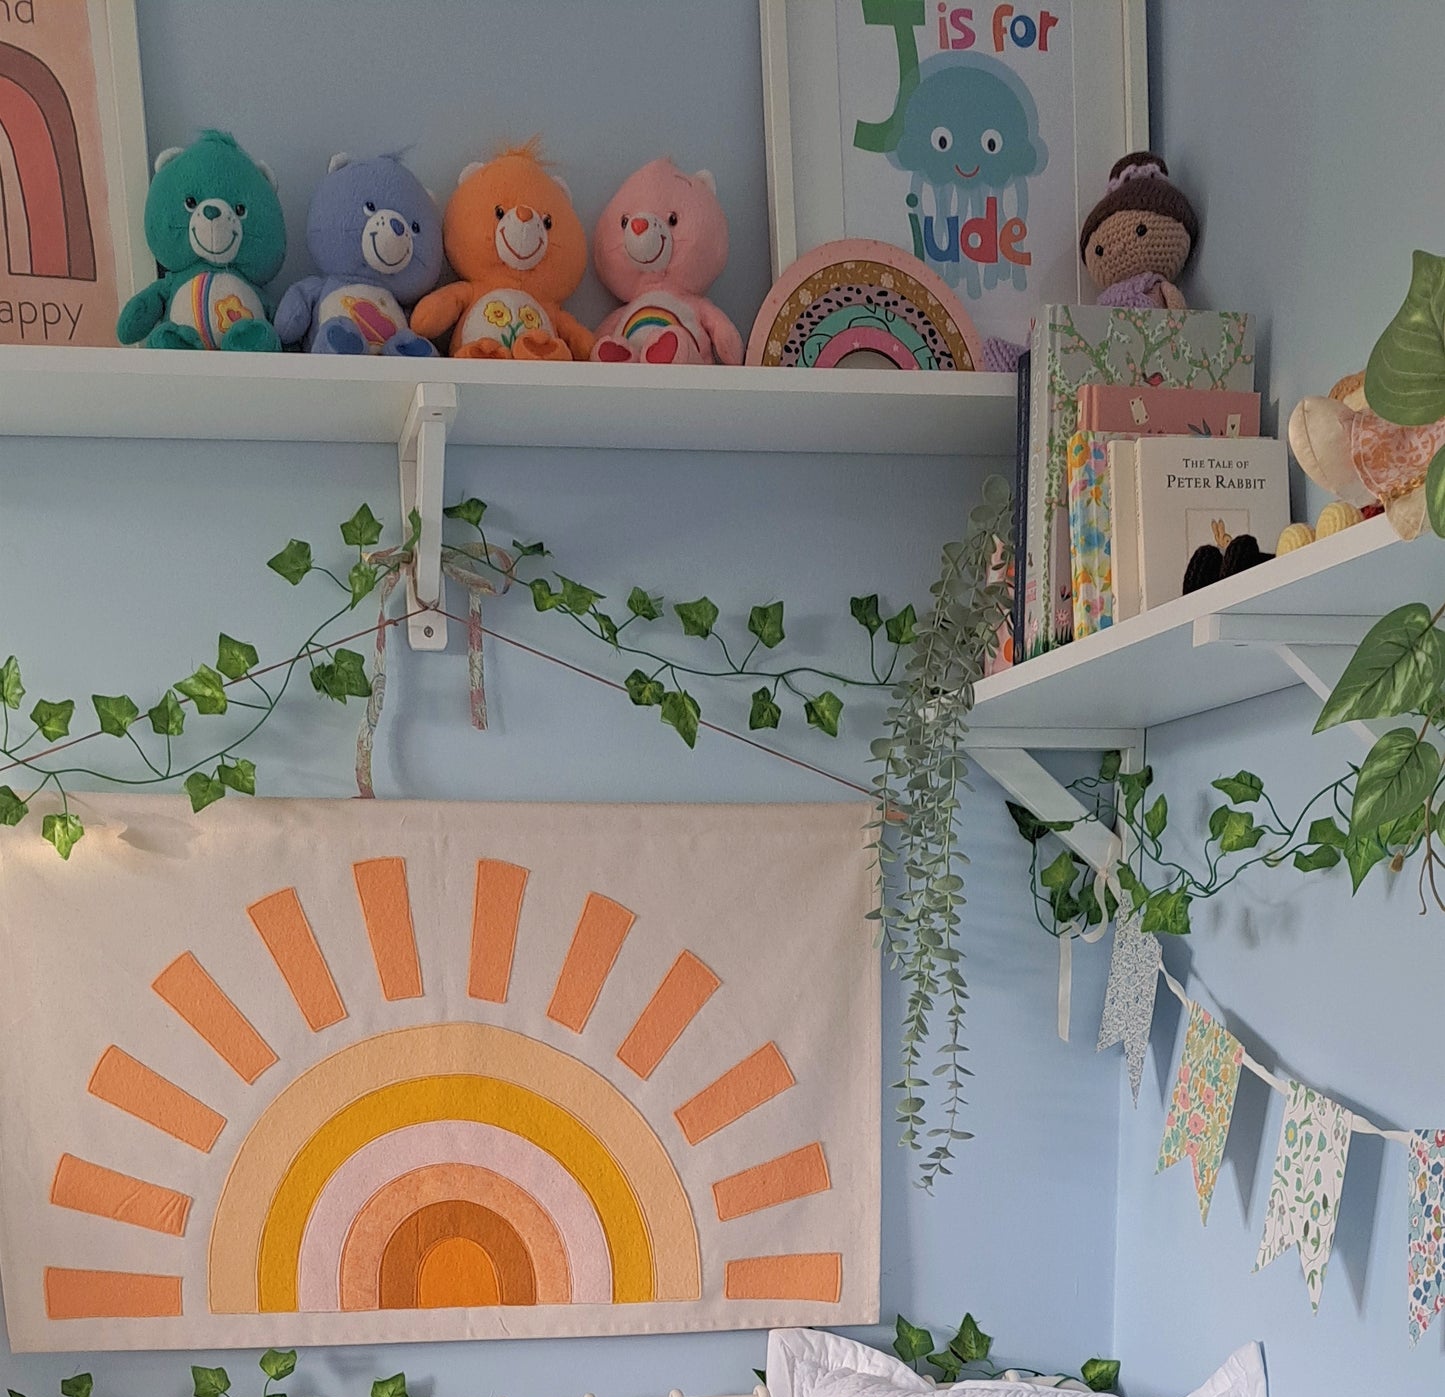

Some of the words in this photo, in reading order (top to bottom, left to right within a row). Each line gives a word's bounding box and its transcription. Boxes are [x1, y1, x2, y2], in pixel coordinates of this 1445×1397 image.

[853, 0, 926, 153] J
[937, 2, 976, 50] is
[992, 4, 1059, 52] for
[1182, 458, 1205, 469] THE
[1207, 458, 1234, 469] TALE
[1166, 474, 1212, 489] PETER
[1215, 474, 1266, 490] RABBIT
